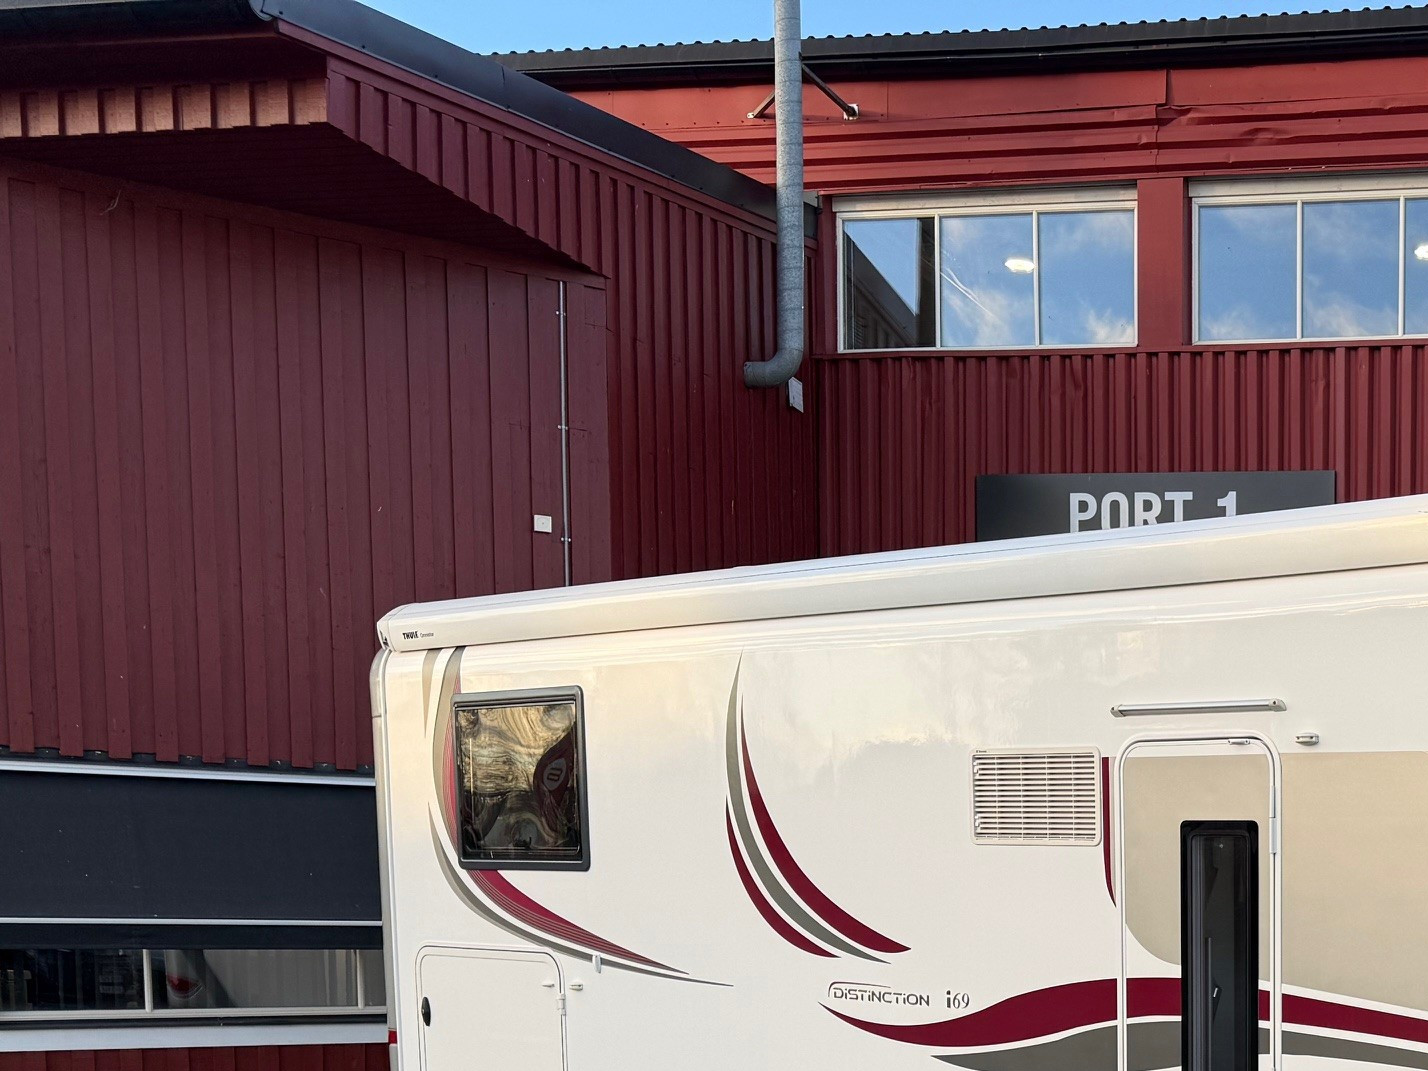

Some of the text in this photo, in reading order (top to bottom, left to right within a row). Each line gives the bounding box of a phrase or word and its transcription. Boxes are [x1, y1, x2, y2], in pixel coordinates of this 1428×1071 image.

[1069, 490, 1237, 533] PORT 1
[402, 631, 419, 640] THULE
[946, 989, 970, 1010] i69
